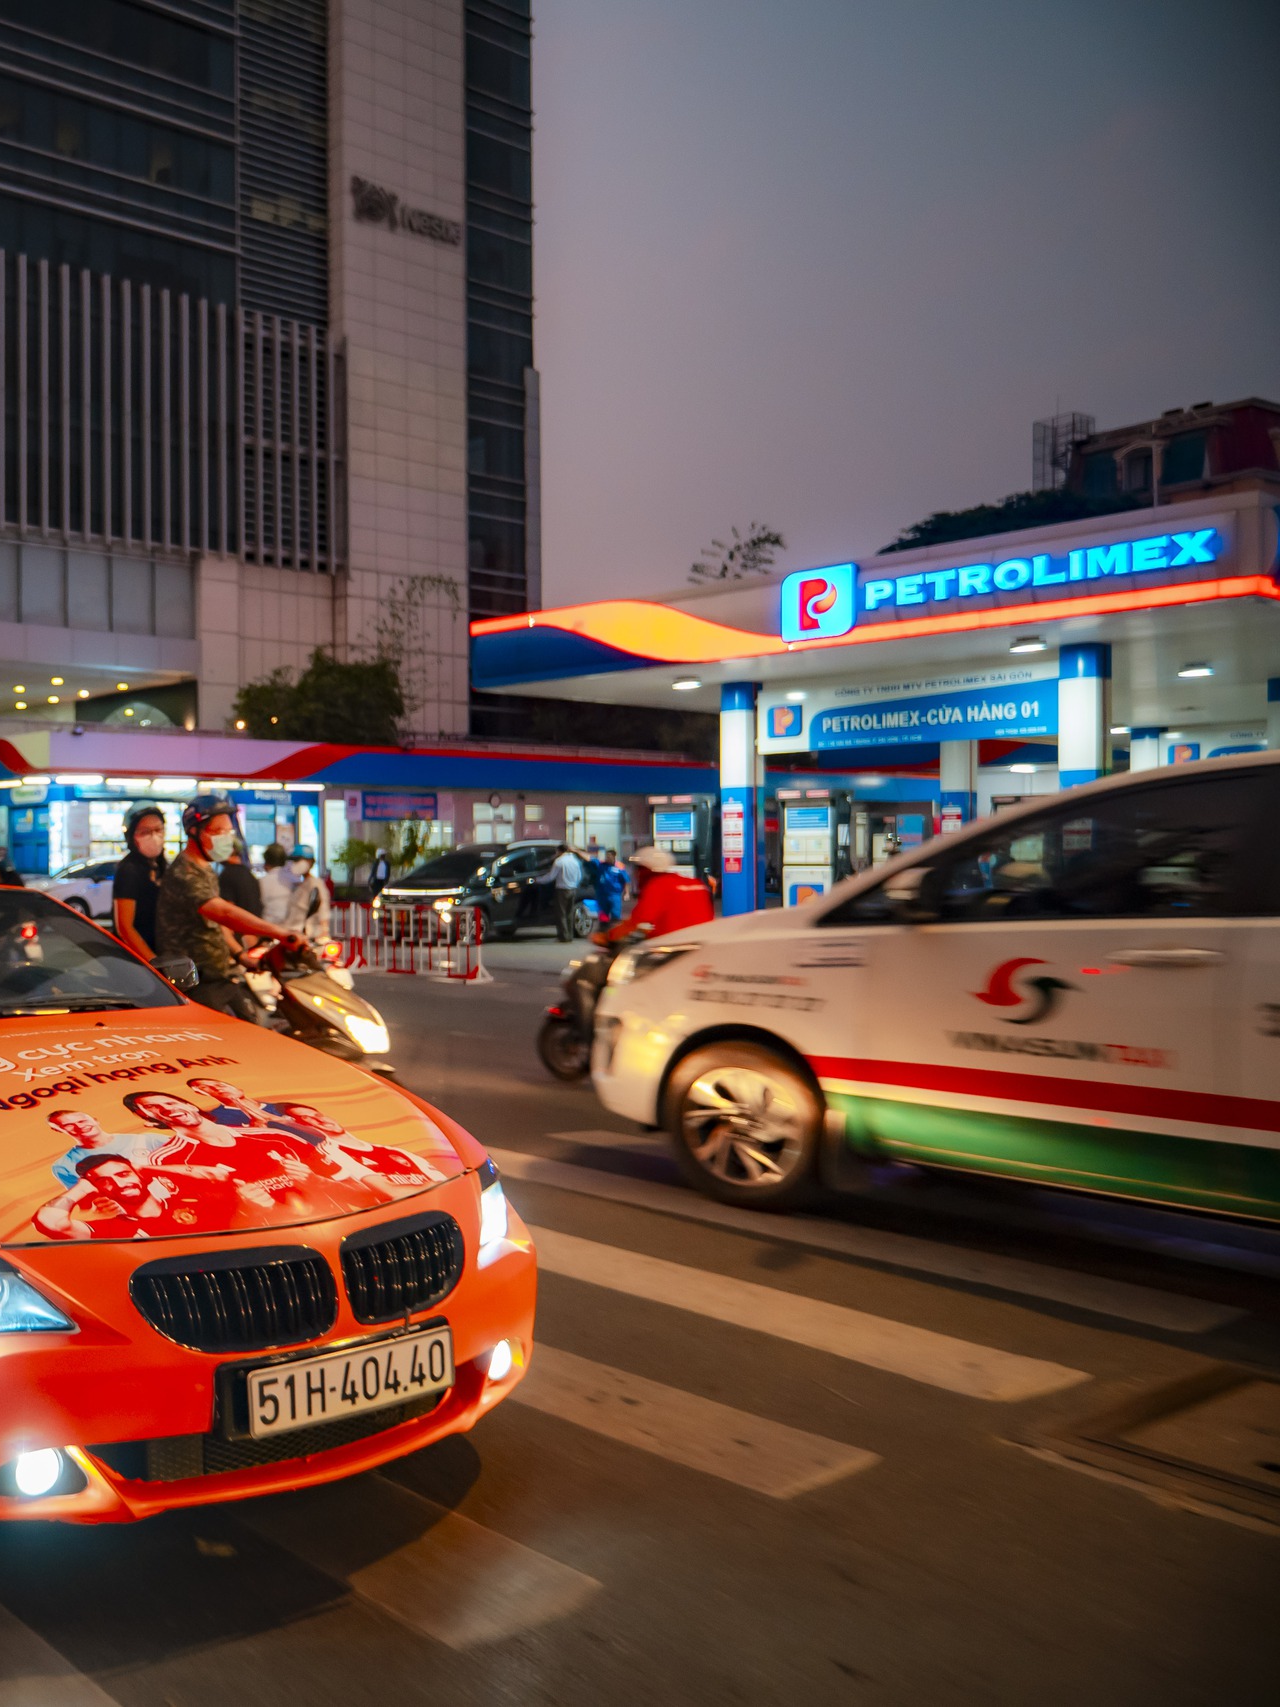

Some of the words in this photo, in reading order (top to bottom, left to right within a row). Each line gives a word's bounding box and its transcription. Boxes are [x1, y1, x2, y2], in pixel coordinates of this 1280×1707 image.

[864, 527, 1218, 611] PETROLIMEX
[822, 703, 962, 733] PETROLIMEX-CỬA
[966, 699, 1017, 724] HÀNG
[1021, 701, 1039, 718] 01
[18, 1041, 95, 1060] cực
[94, 1031, 224, 1047] nhanh
[93, 1048, 162, 1064] trọn
[83, 1062, 182, 1081] hạng
[176, 1054, 240, 1070] Anh
[257, 1339, 446, 1426] 51H-404.40
